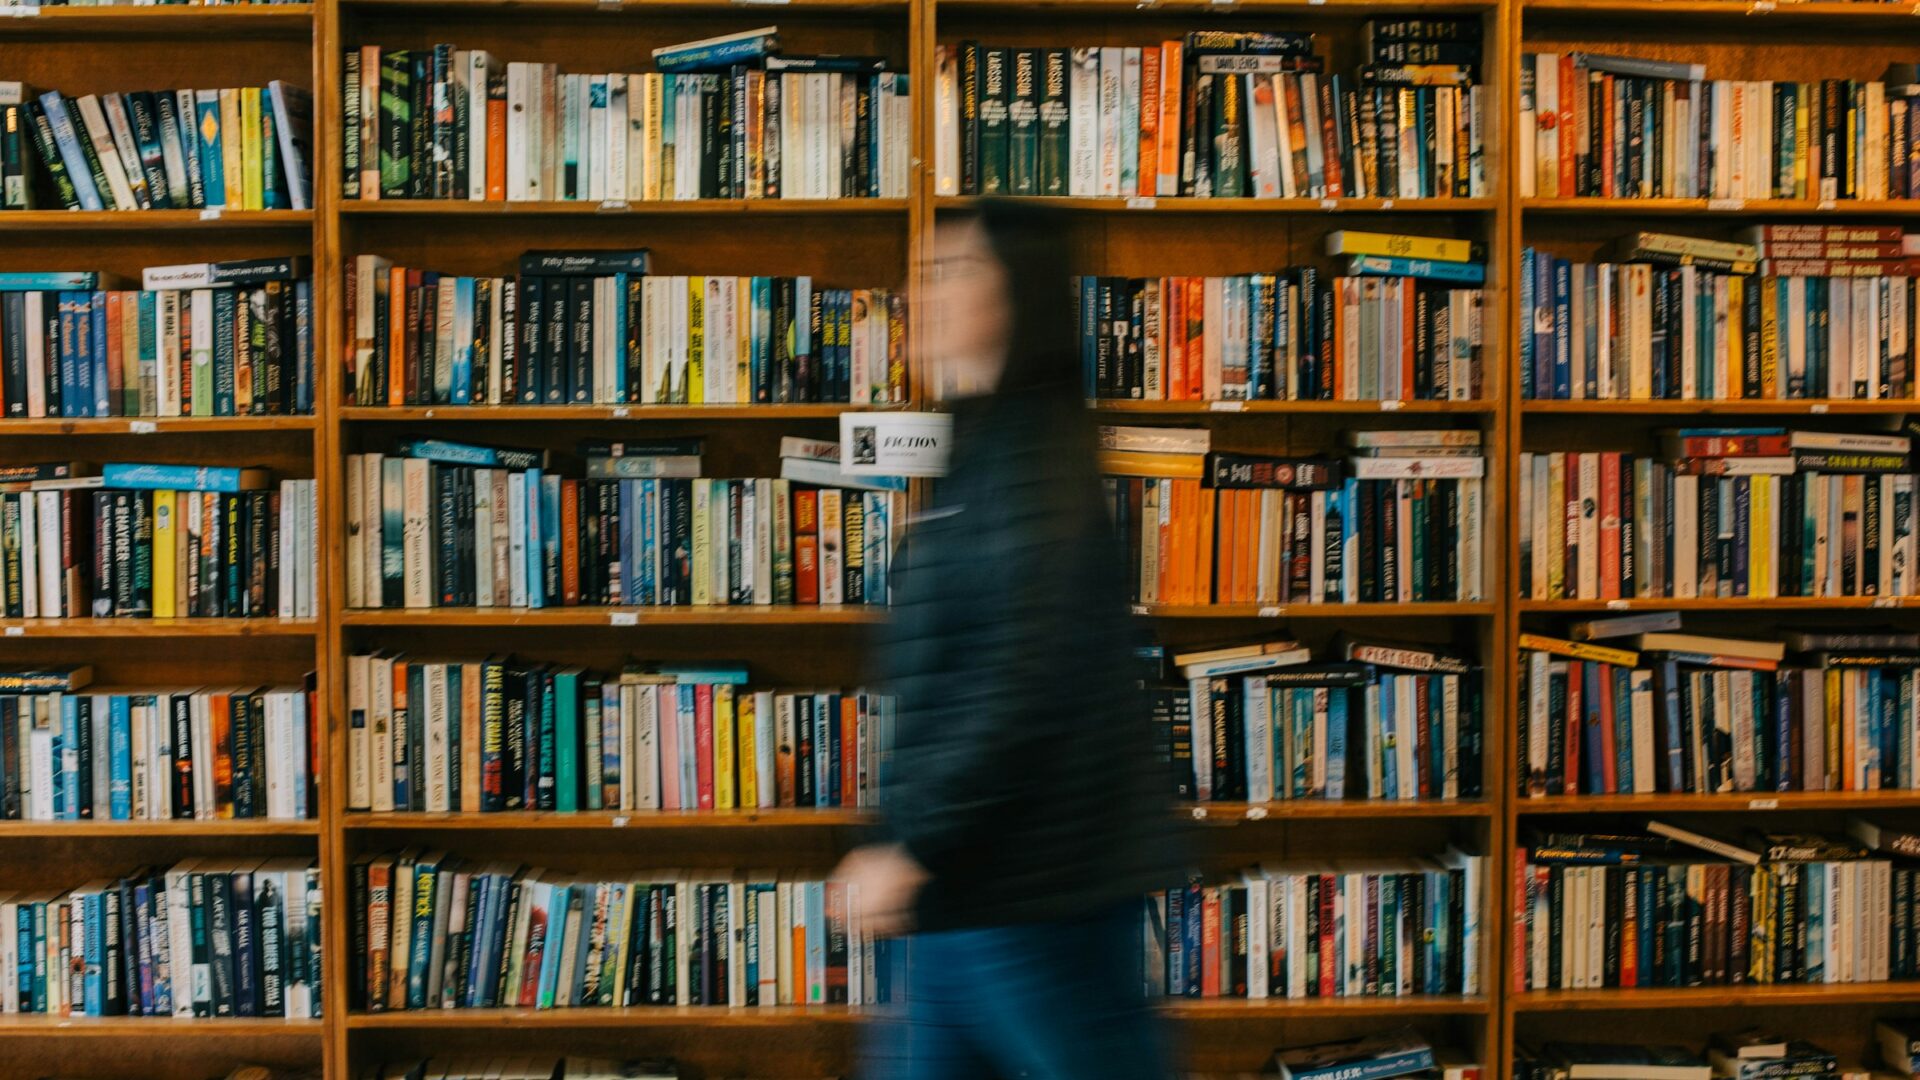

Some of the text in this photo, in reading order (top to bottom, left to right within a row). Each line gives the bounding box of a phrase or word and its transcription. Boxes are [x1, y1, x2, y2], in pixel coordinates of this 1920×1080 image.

[987, 52, 1002, 95] LARSSON
[1017, 53, 1032, 96] LARSSON
[1048, 53, 1063, 96] LARSSON
[504, 282, 515, 360] STAR NORTH
[529, 302, 539, 354] Fifty Shades
[553, 301, 563, 353] Fifty Shades
[580, 301, 590, 353] Fifty Shades
[1085, 287, 1096, 336] sightseeing
[1099, 338, 1107, 380] LEMAITRE
[883, 436, 939, 449] FICTION
[116, 515, 129, 602] HAYDER BIRDMAN
[485, 665, 503, 690] FAYE
[234, 700, 248, 768] MATT HILTON
[485, 692, 503, 753] KELLERMAN
[1214, 699, 1226, 759] MONUMENT
[262, 906, 278, 926] TWO
[262, 928, 278, 971] SOLDIERS
